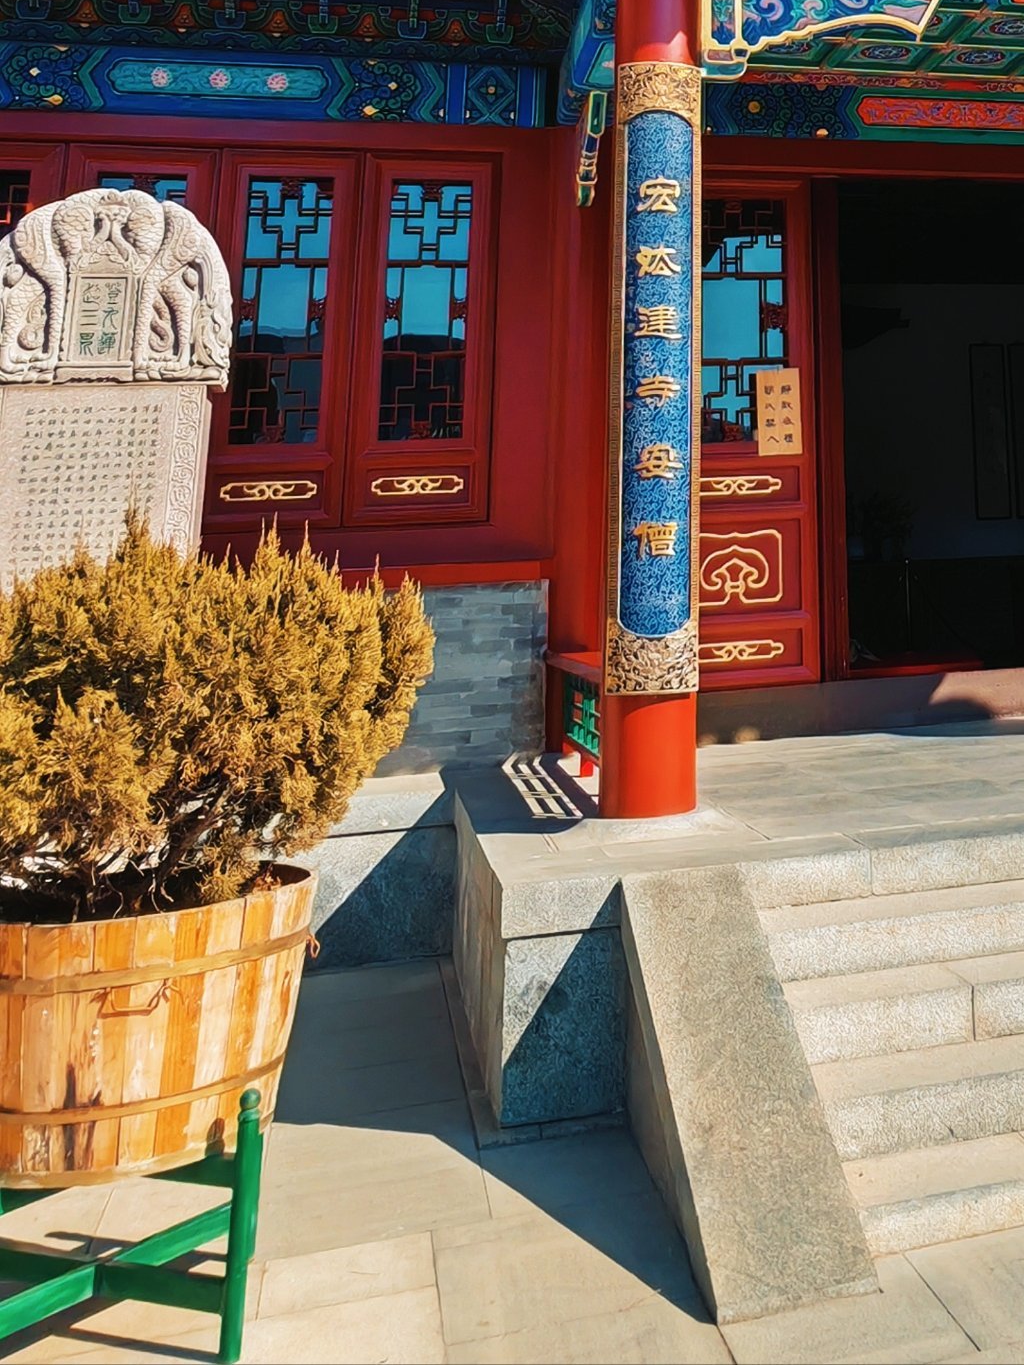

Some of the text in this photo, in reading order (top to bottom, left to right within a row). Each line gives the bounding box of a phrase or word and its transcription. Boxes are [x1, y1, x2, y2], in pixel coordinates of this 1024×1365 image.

[634, 175, 684, 558] 宏法建寺安僧
